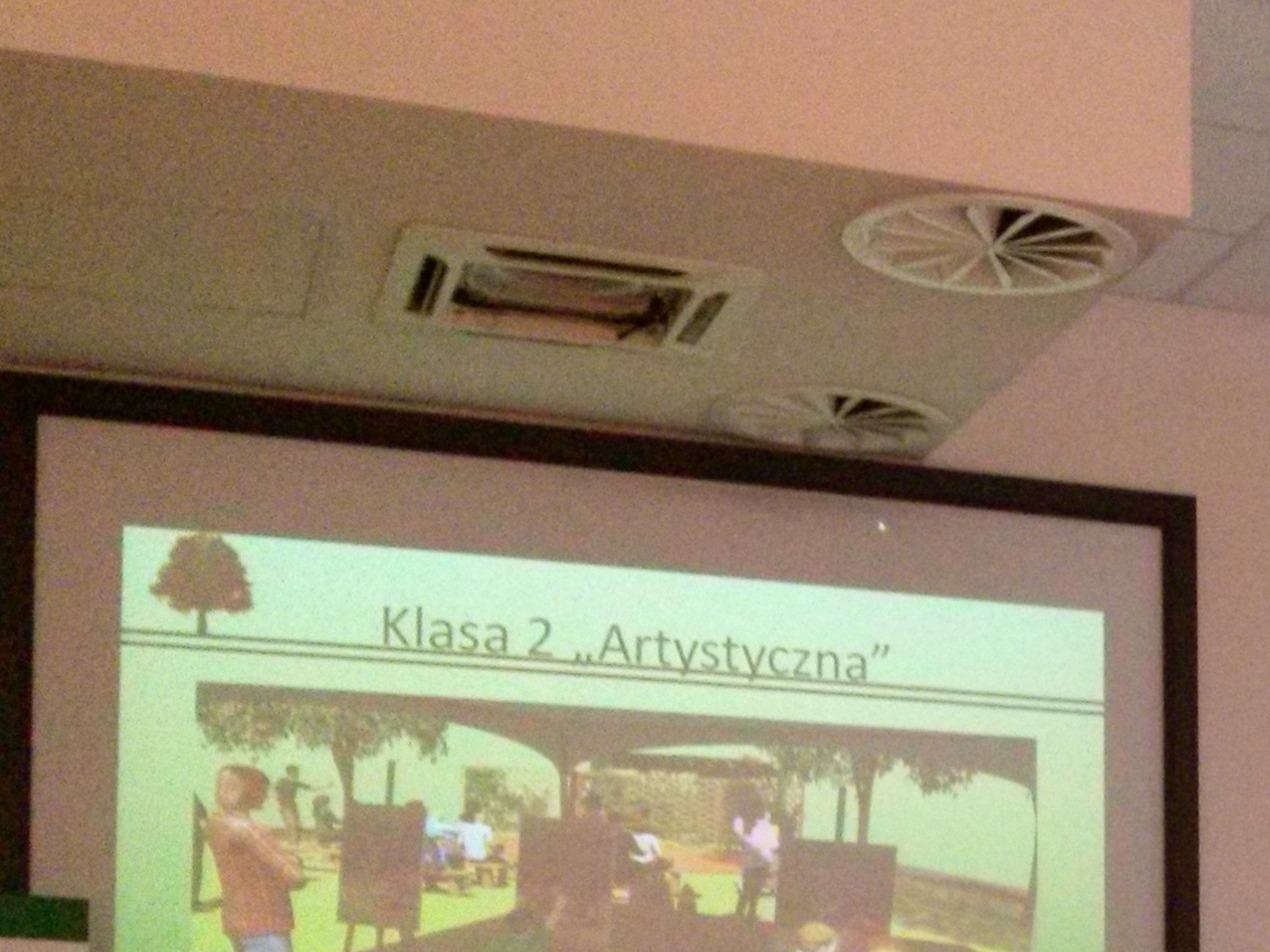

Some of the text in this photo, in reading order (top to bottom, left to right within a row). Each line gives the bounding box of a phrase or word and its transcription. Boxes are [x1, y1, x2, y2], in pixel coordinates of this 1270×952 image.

[382, 605, 890, 683] Klasa 2 „Artystyczna”
